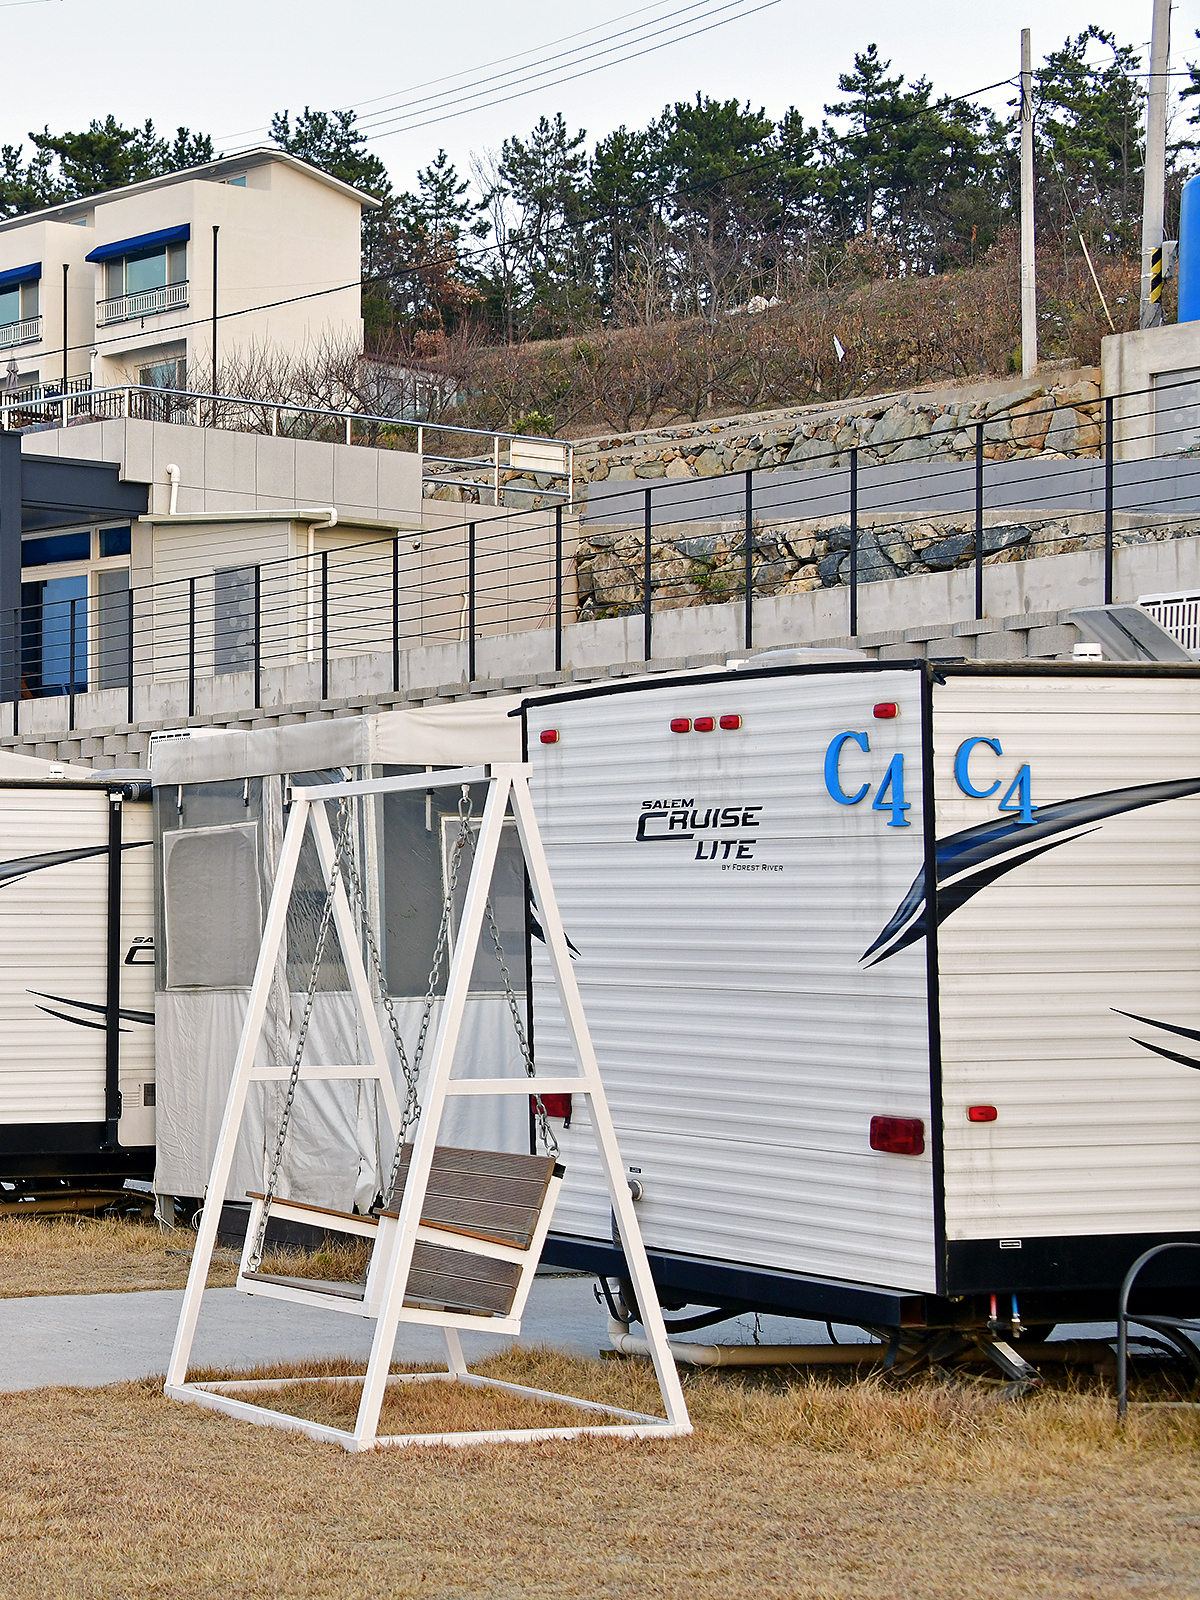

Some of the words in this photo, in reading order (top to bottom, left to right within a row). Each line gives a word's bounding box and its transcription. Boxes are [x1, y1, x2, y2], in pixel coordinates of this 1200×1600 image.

[824, 730, 912, 827] C4
[954, 736, 1039, 825] C4
[641, 798, 695, 810] SALEM
[636, 806, 763, 841] CRUISE
[694, 839, 757, 860] LITE
[732, 863, 760, 872] FOREST
[761, 864, 784, 872] RIVER
